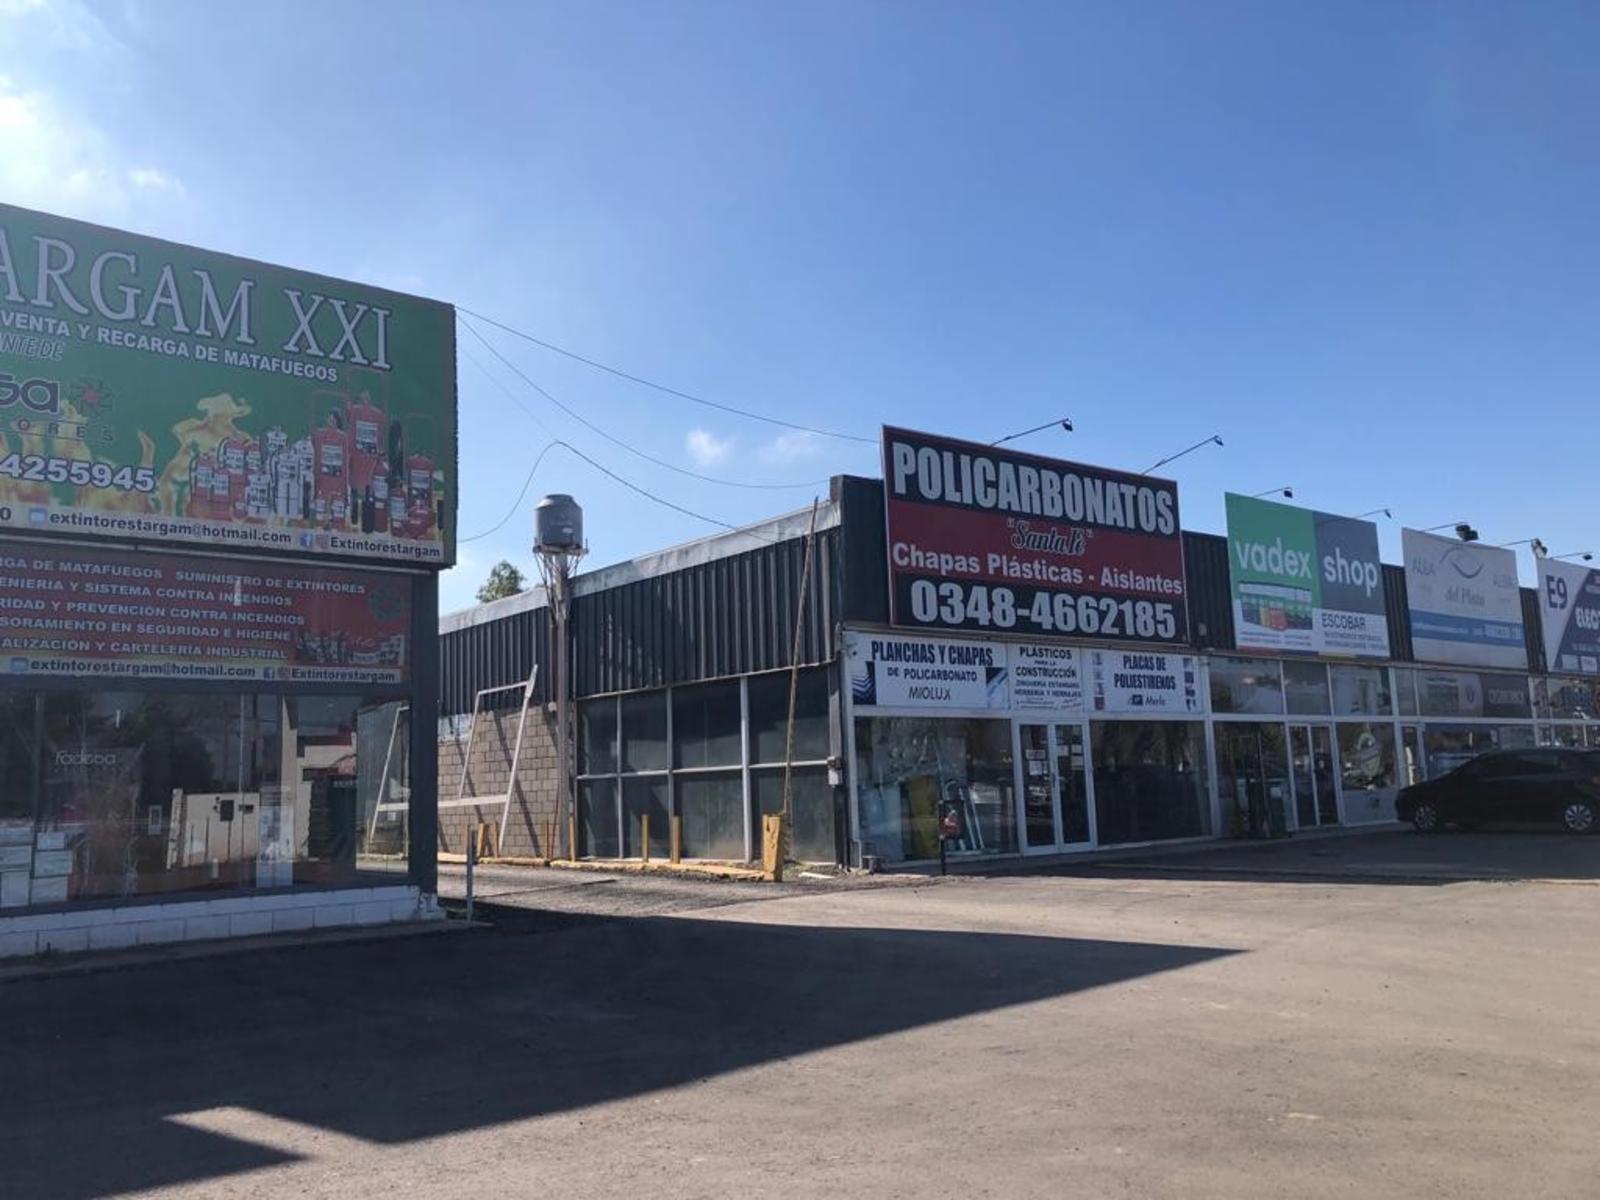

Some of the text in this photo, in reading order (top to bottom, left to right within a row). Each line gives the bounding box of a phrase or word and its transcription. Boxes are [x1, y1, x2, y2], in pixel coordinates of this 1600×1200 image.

[284, 289, 391, 369] XXI
[0, 311, 338, 382] VENTA Y RECARGA DE MATAFUEGOS
[0, 453, 155, 492] 4255945
[893, 442, 1176, 536] POLICARBONATOS
[50, 513, 292, 544] extintorestargam@hotmail.com
[330, 537, 440, 558] Extintorestargam
[1236, 537, 1312, 579] vadex
[33, 559, 54, 571] DE
[59, 562, 163, 579] MATAFUEGOS
[893, 542, 980, 575] Chapas
[987, 554, 1083, 584] Plásticas
[1101, 567, 1183, 595] Aislantes
[1323, 547, 1377, 597] shop
[70, 582, 79, 592] Y
[85, 582, 151, 597] SISTEMA
[156, 587, 215, 601] CONTRA
[219, 592, 292, 606] INCENDIOS
[176, 570, 365, 594] SUMINISTRO DE EXTINTORES
[1546, 574, 1567, 609] E9
[51, 601, 61, 611] Y
[170, 607, 228, 621] CONTRA
[232, 611, 305, 625] INCENDIOS
[911, 580, 1176, 638] 0348-4662185
[0, 616, 290, 641] SORAMIENTO EN SEGURIDAD E HIGIENE
[1322, 613, 1365, 630] ESCOBAR
[95, 641, 106, 651] Y
[206, 647, 288, 660] INDUSTRIAL
[872, 640, 993, 666] PLANCHAS Y CHAPAS
[1123, 655, 1166, 670] PLACAS DE
[31, 657, 255, 678] extintorestargam@hotmail.com
[292, 668, 395, 682] Extintorestargam
[888, 667, 977, 682] DE POLICARBONATO
[909, 686, 951, 700] MIOLUX
